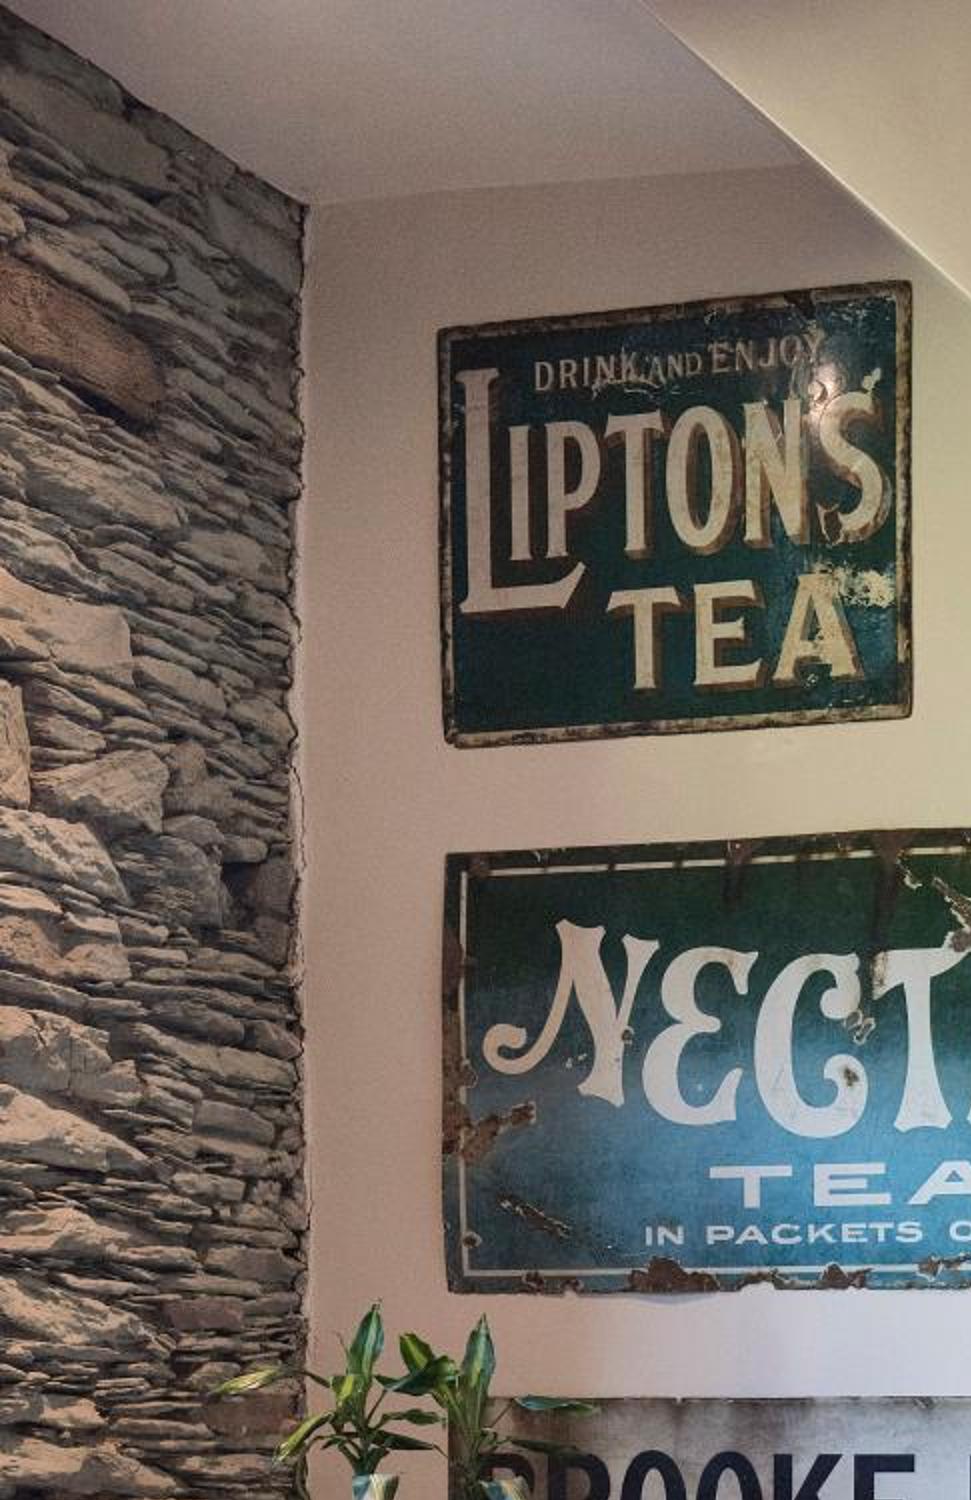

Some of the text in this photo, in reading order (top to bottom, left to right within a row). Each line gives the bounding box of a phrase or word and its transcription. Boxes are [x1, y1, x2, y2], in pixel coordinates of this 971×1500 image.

[534, 329, 823, 392] DRINK AND ENJOY
[606, 572, 864, 690] TEA
[645, 1226, 685, 1246] IN
[706, 1221, 924, 1245] PACKETS
